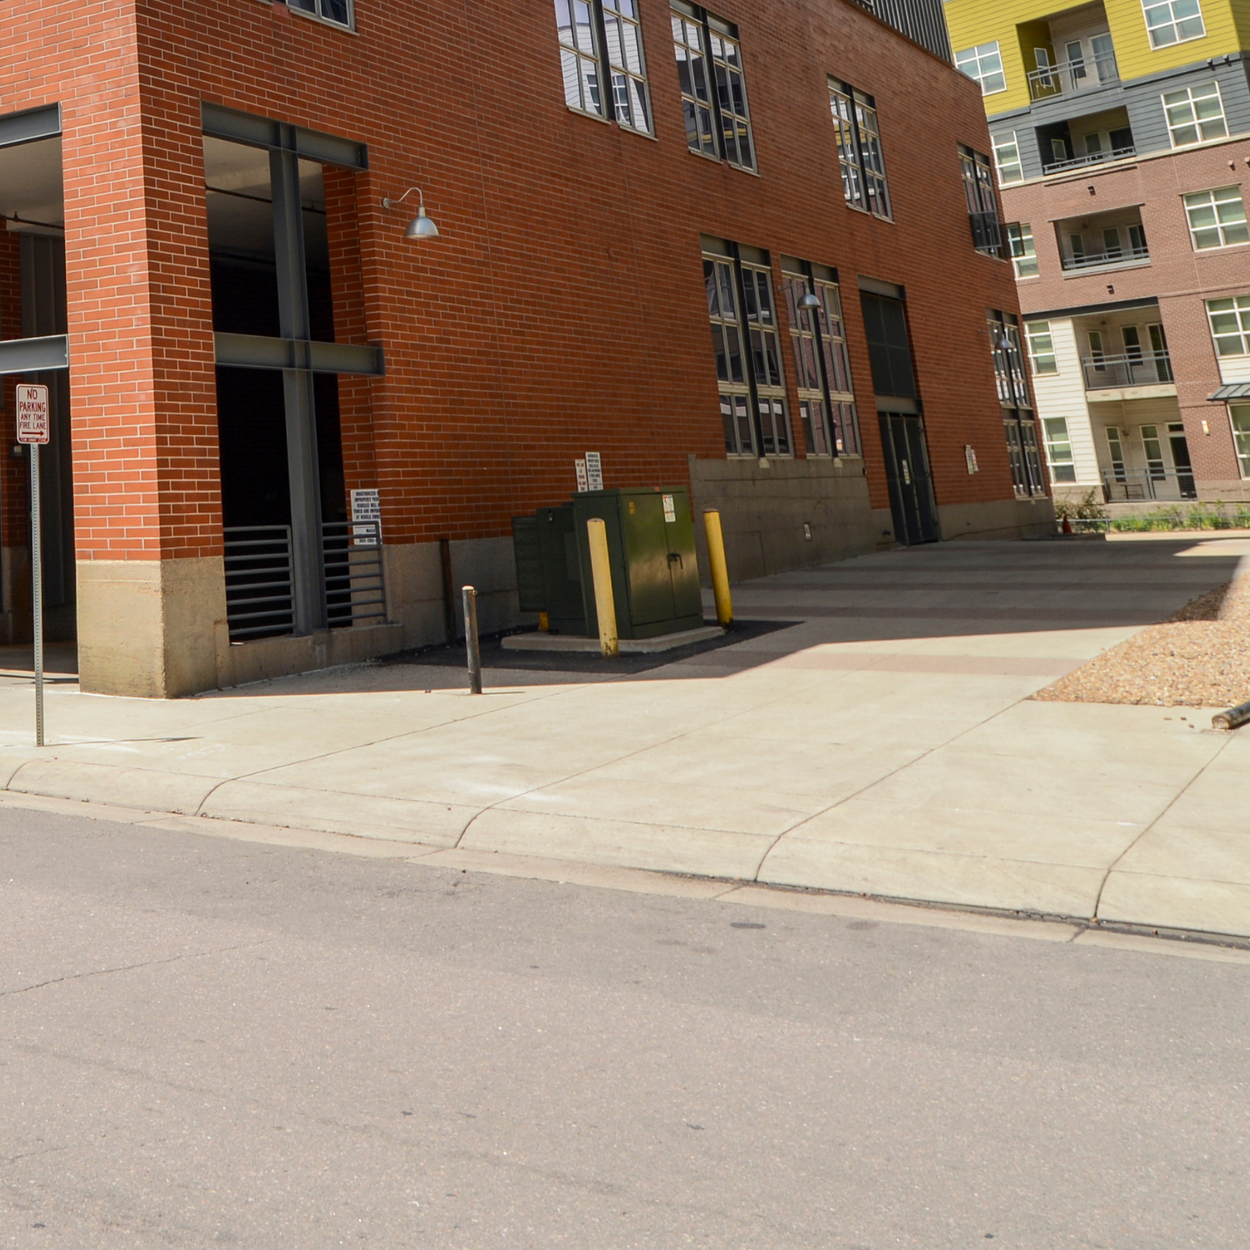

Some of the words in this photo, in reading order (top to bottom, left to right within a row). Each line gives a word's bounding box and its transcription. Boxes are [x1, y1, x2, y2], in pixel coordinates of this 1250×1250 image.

[27, 389, 38, 400] NO
[19, 401, 46, 413] PARKING
[21, 413, 32, 421] ANY
[33, 414, 46, 422] TIME
[33, 422, 47, 430] LANE
